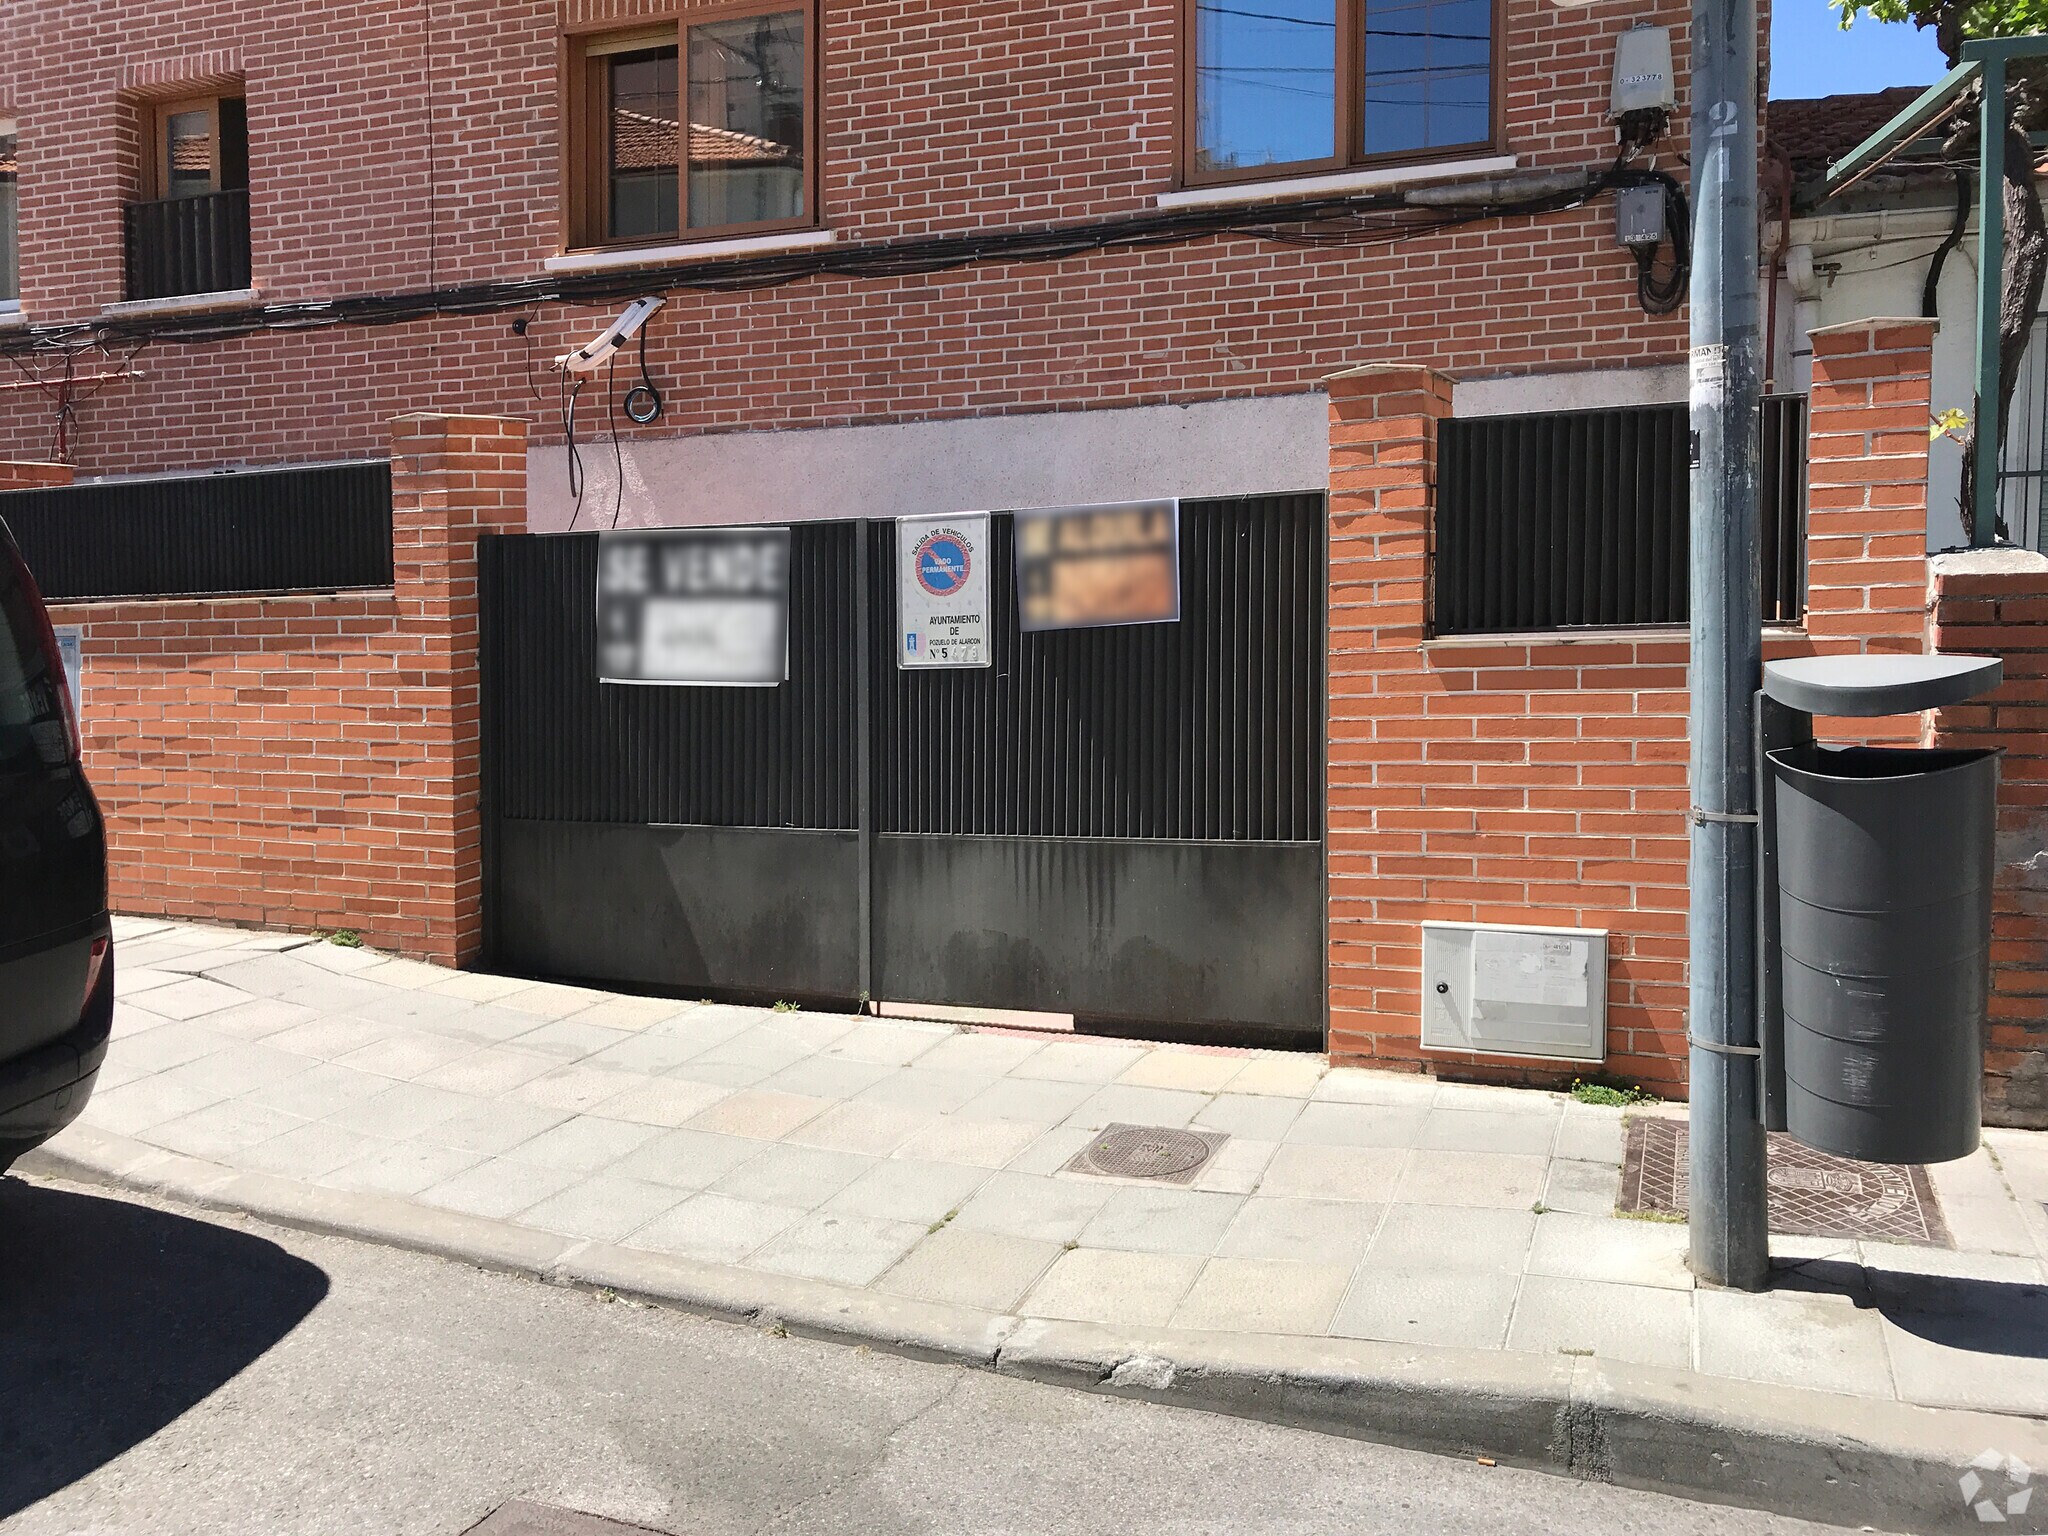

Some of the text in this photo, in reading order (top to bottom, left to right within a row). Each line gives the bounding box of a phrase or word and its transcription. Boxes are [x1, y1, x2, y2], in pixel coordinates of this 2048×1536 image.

[911, 528, 974, 556] SALIDA DE VEHICULOS
[934, 557, 952, 566] VADO
[921, 564, 964, 574] PERMANENTE
[929, 614, 980, 625] AYUNTAMIENTO
[949, 626, 959, 636] DE
[929, 637, 981, 646] POZUELO DE ALARCON
